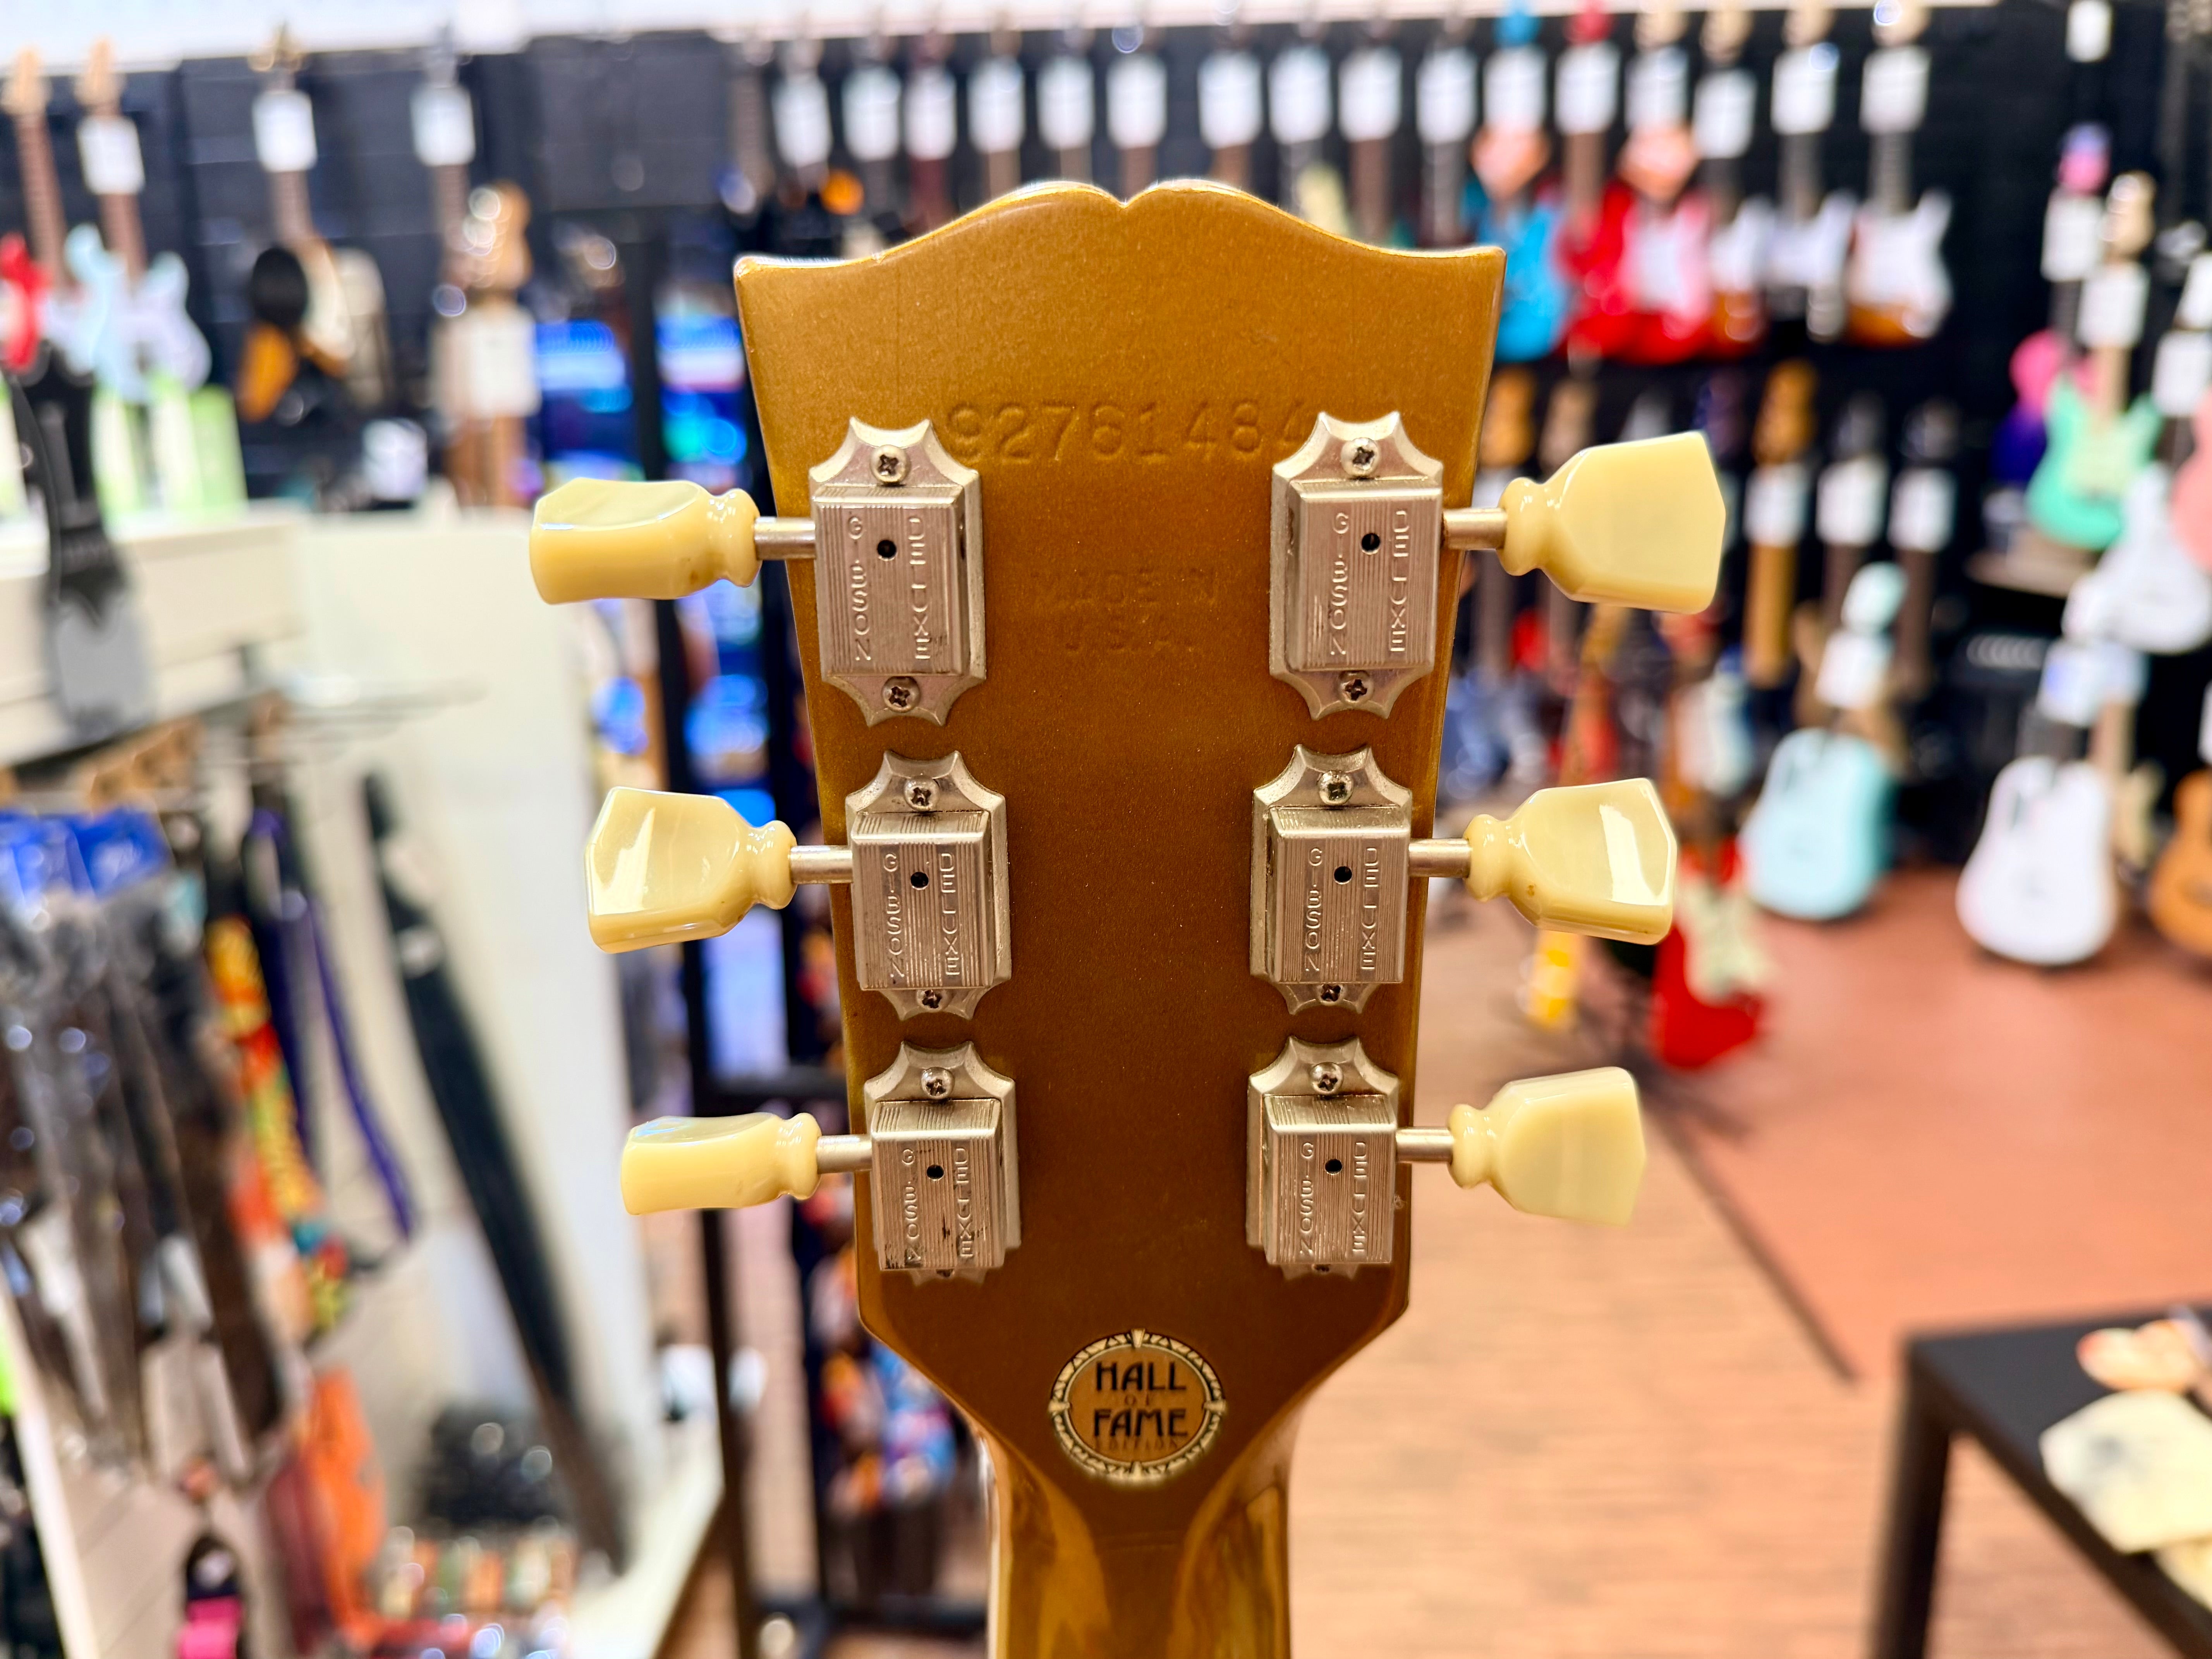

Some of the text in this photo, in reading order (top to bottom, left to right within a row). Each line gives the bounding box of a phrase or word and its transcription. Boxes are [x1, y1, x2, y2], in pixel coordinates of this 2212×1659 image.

[848, 516, 871, 661] GIBSON
[908, 516, 931, 659] DELUXE
[1330, 512, 1349, 655] GIBSON
[1389, 510, 1410, 652] DELUXE
[883, 854, 905, 978] GIBSON
[939, 853, 960, 975] DELUXE
[1304, 848, 1322, 972] GIBSON
[1362, 847, 1379, 970] DELUXE
[902, 1149, 921, 1261] GIBSON
[954, 1147, 974, 1258] DELUXE
[1300, 1142, 1314, 1255] GIBSON
[1352, 1142, 1368, 1252] DELUXE
[1094, 1408, 1188, 1437] FAME
[1096, 1362, 1187, 1391] HALL
